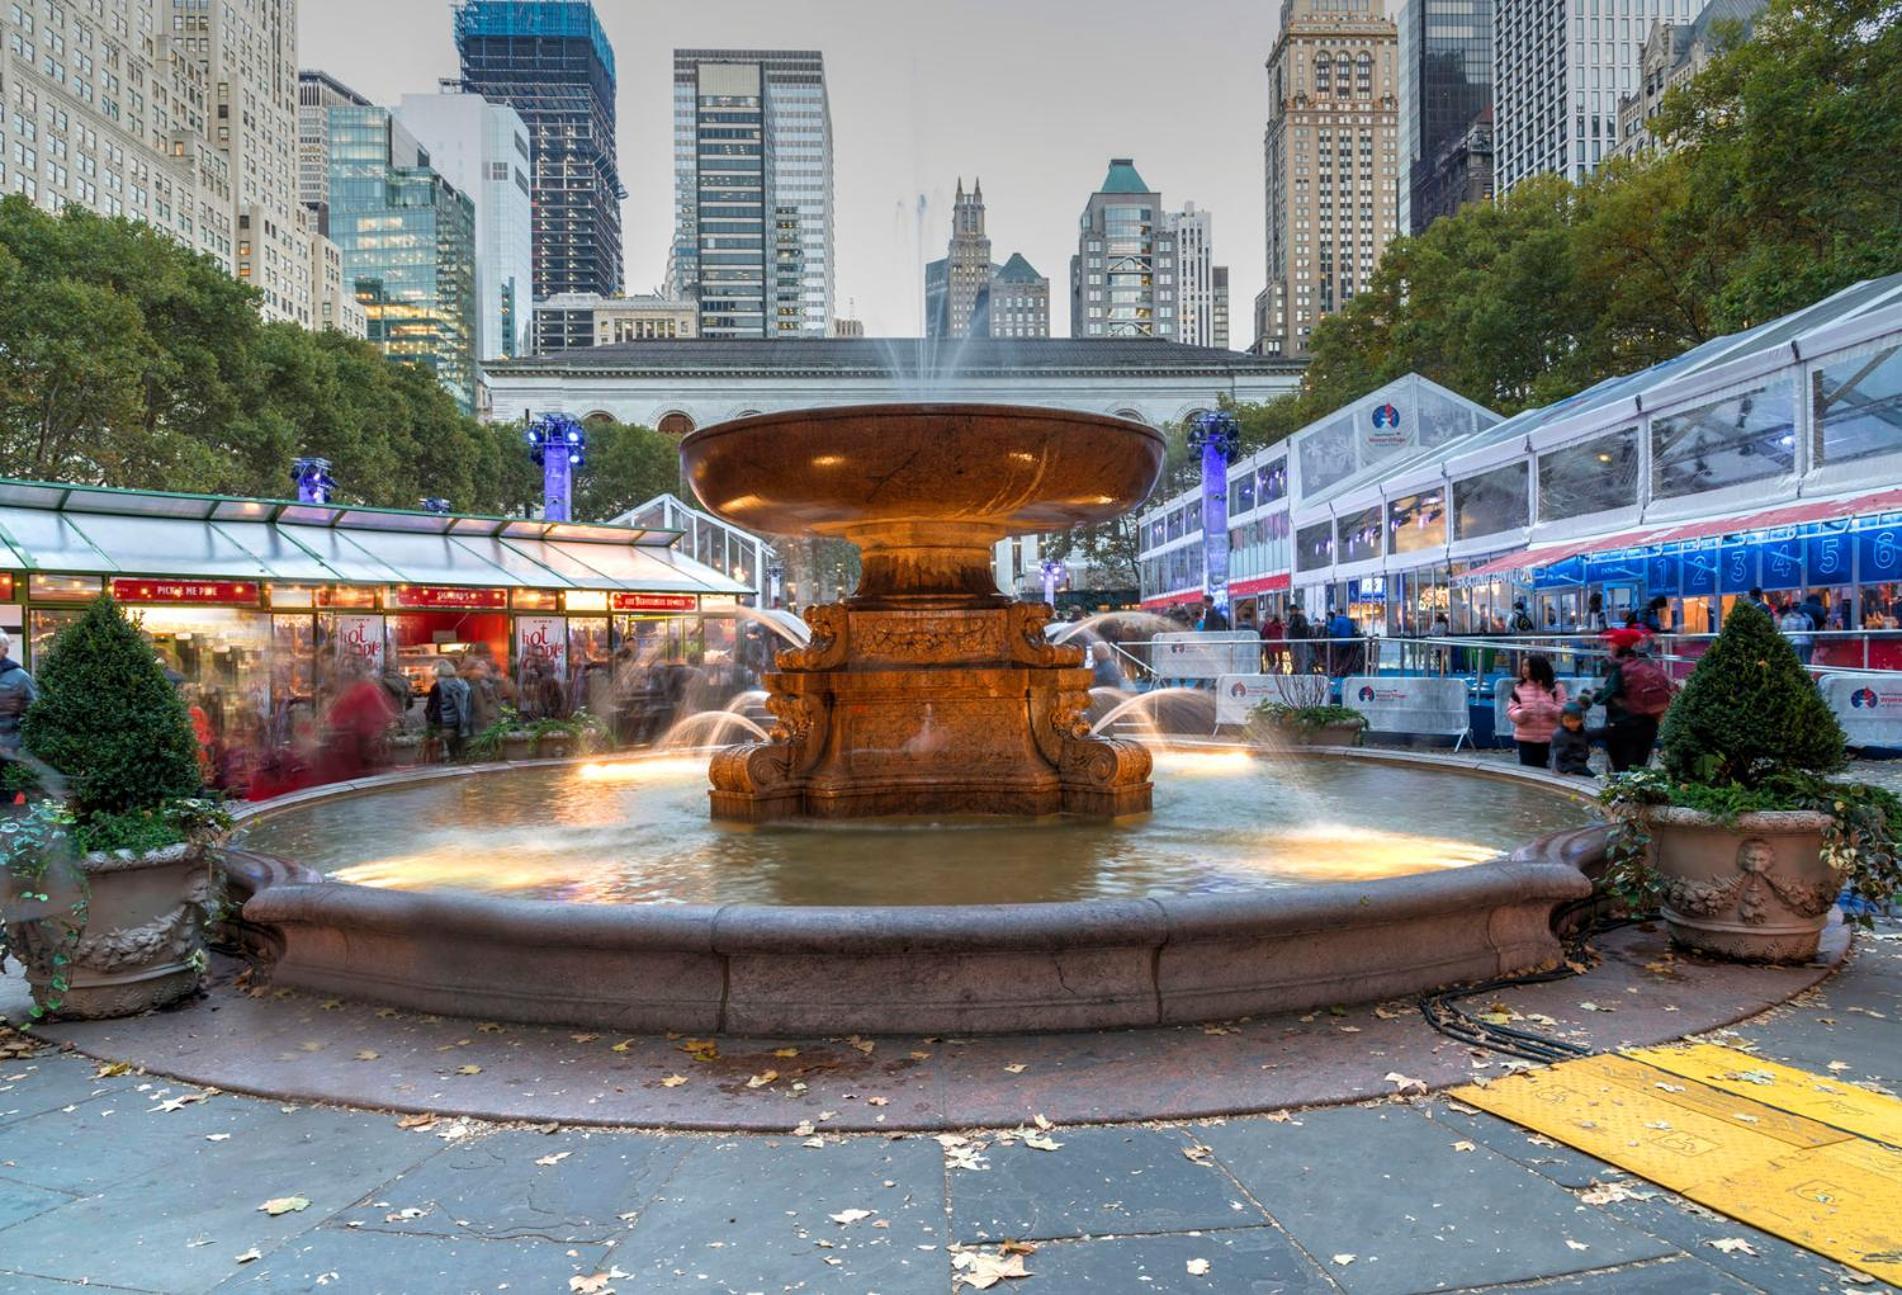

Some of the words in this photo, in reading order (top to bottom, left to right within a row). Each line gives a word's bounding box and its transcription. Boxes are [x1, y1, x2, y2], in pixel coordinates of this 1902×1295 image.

[1657, 558, 1668, 587] 1
[1693, 556, 1706, 585] 2
[1732, 551, 1746, 583] 3
[1772, 545, 1791, 577] 4
[1819, 538, 1840, 575] 5
[1873, 532, 1896, 569] 6
[157, 586, 183, 597] PICKE
[185, 587, 197, 597] ME
[198, 587, 217, 597] PE
[522, 624, 549, 646] hot
